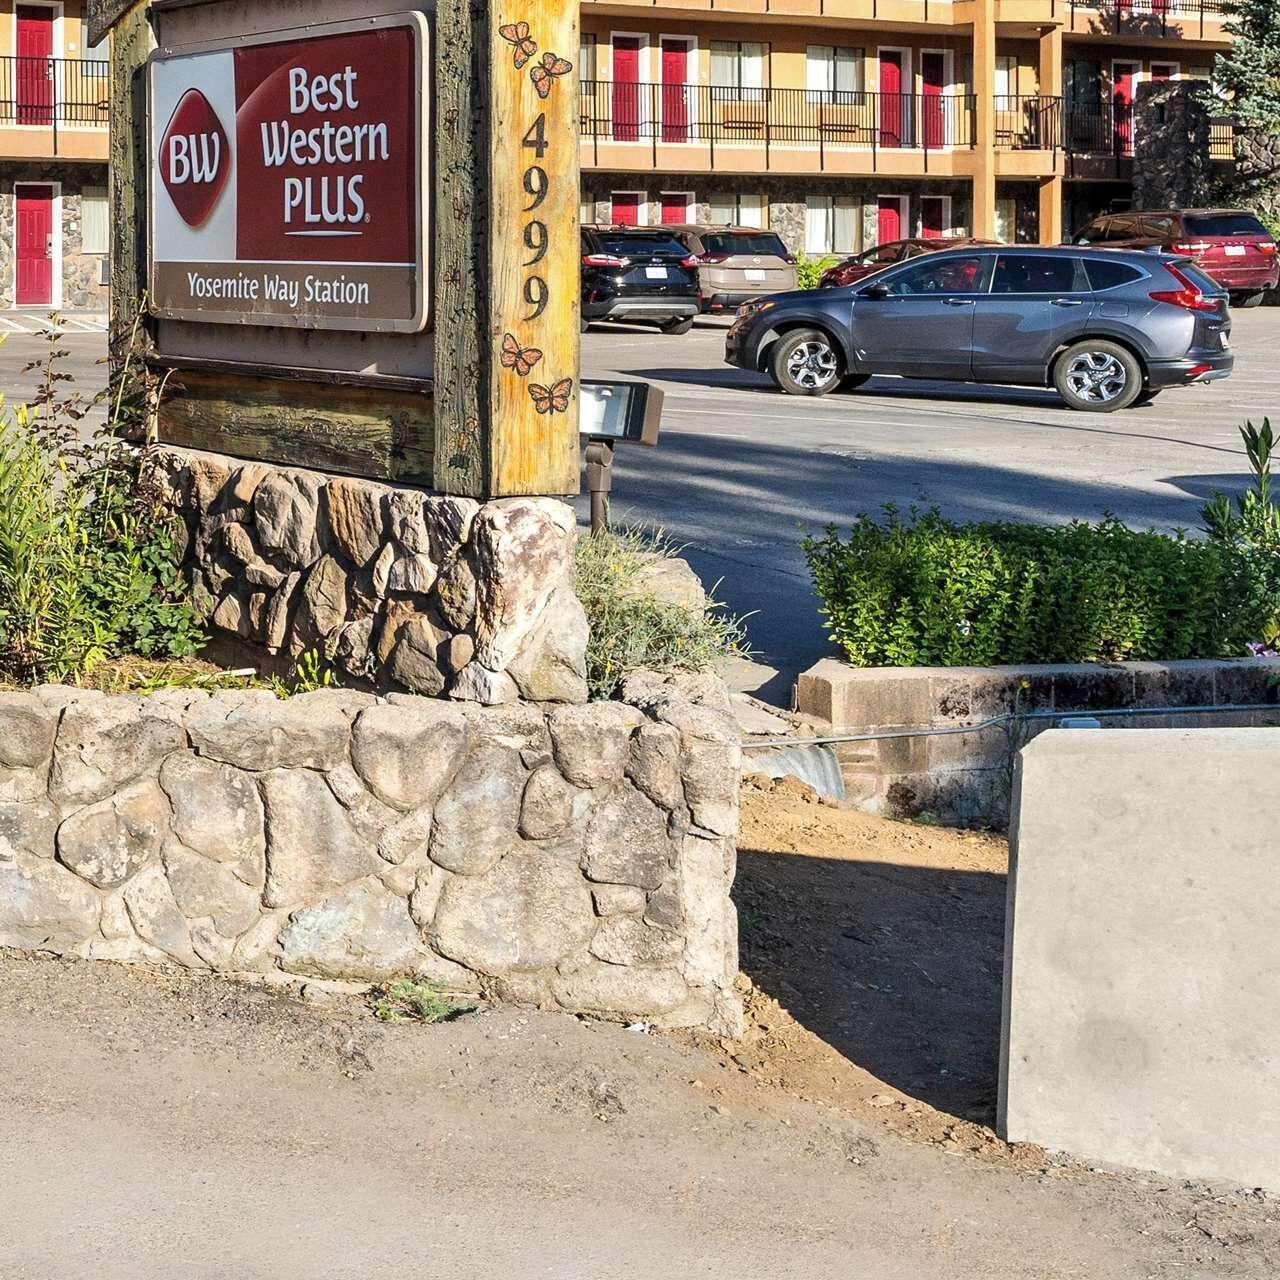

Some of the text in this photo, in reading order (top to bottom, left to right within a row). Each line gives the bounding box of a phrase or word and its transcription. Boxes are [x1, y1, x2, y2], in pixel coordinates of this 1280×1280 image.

[288, 65, 359, 115] Best
[169, 131, 220, 185] BW
[260, 120, 390, 167] Western
[284, 174, 366, 224] PLUS
[522, 112, 549, 322] 4999
[187, 272, 370, 307] Yosemite Way Station
